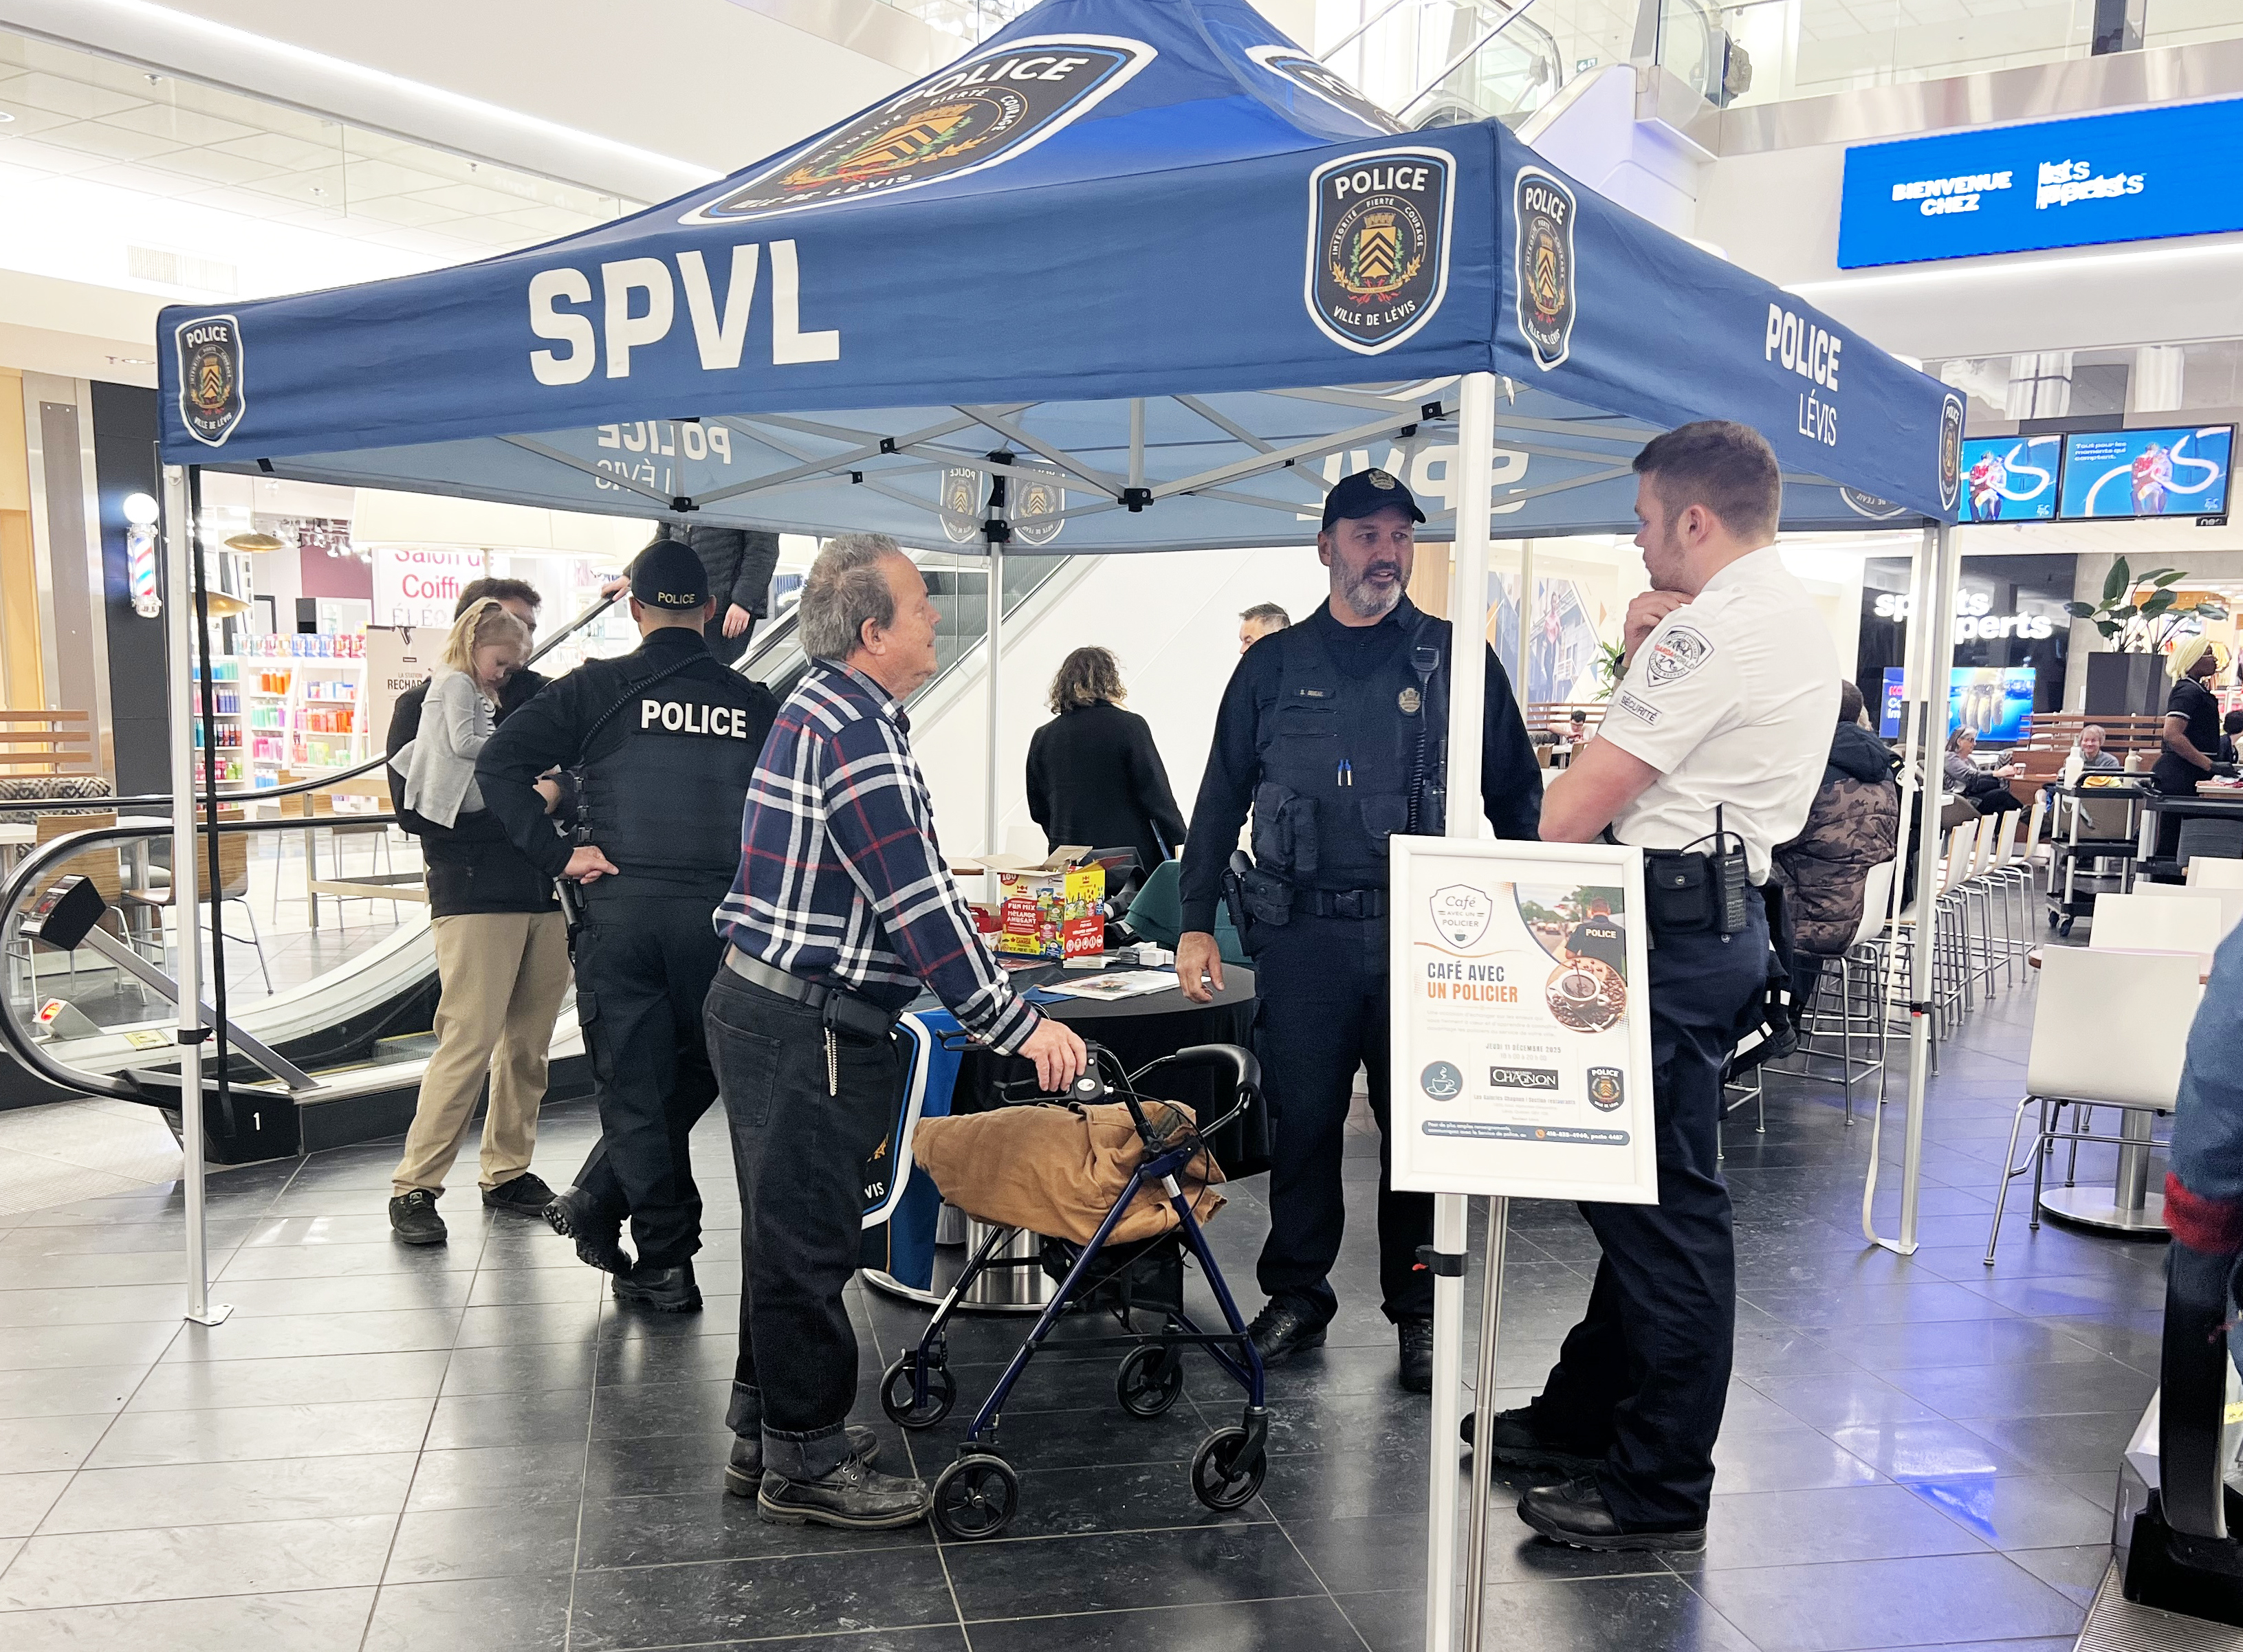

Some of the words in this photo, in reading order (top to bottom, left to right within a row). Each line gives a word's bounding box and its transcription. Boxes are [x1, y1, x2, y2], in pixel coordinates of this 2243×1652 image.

[885, 57, 1089, 115] POLICE
[930, 88, 990, 106] FIERTÉ
[992, 94, 1019, 132] COURAGE
[826, 174, 912, 197] LÉVIS
[1335, 166, 1429, 199] POLICE
[1892, 170, 2013, 201] BIENVENUE
[1525, 187, 1566, 225] POLICE
[1919, 193, 1980, 217] CHEZ
[1332, 209, 1357, 256] INTÉGRITÉ
[1366, 197, 1394, 208] FIERTÉ
[1404, 206, 1424, 247] COURAGE
[527, 239, 840, 386] SPVL
[1333, 305, 1362, 326] VILLE
[1366, 313, 1380, 326] DE
[1384, 300, 1416, 323] LÉVIS
[186, 325, 228, 349] POLICE
[1527, 318, 1542, 342] VILLE
[1548, 327, 1561, 344] LÉVIS
[1765, 302, 1842, 393] POLICE
[1799, 388, 1837, 447] LÉVIS
[1945, 405, 1960, 425] POLICE
[657, 591, 696, 605] POLICE
[1874, 588, 1990, 622] spts
[1955, 610, 2053, 644] perts
[387, 679, 423, 690] RECHAR
[641, 699, 747, 739] POLICE
[1621, 695, 1658, 722] SÉCURITÉ
[1445, 895, 1476, 910] Café
[1442, 919, 1479, 927] POLICIER
[1586, 928, 1617, 938] POLICE
[1427, 960, 1463, 980] CAFÉ
[1468, 965, 1505, 982] AVEC
[1427, 982, 1447, 999] UN
[1453, 983, 1518, 1003] POLICIER
[1512, 1044, 1543, 1052] DÉCEMBRE
[1492, 1068, 1556, 1087] CHAGNON
[1591, 1069, 1619, 1077] POLICE
[252, 1112, 260, 1131] 1
[864, 1181, 885, 1200] VIS
